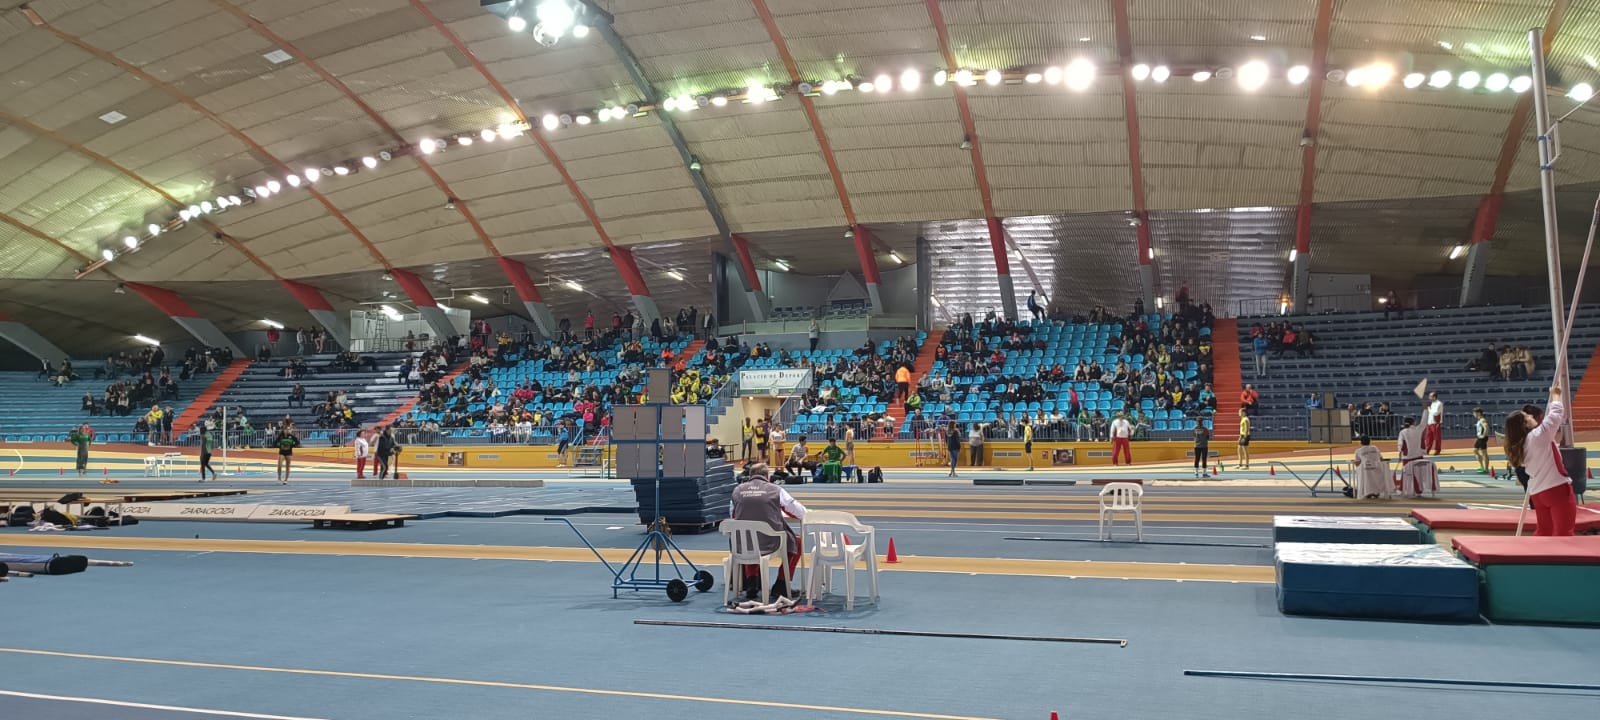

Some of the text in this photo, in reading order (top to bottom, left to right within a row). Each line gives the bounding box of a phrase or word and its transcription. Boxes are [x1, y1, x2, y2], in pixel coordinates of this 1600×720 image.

[779, 371, 812, 379] DEPORT
[180, 507, 235, 515] ZARAGOZA
[268, 508, 326, 517] ZARAGOZA
